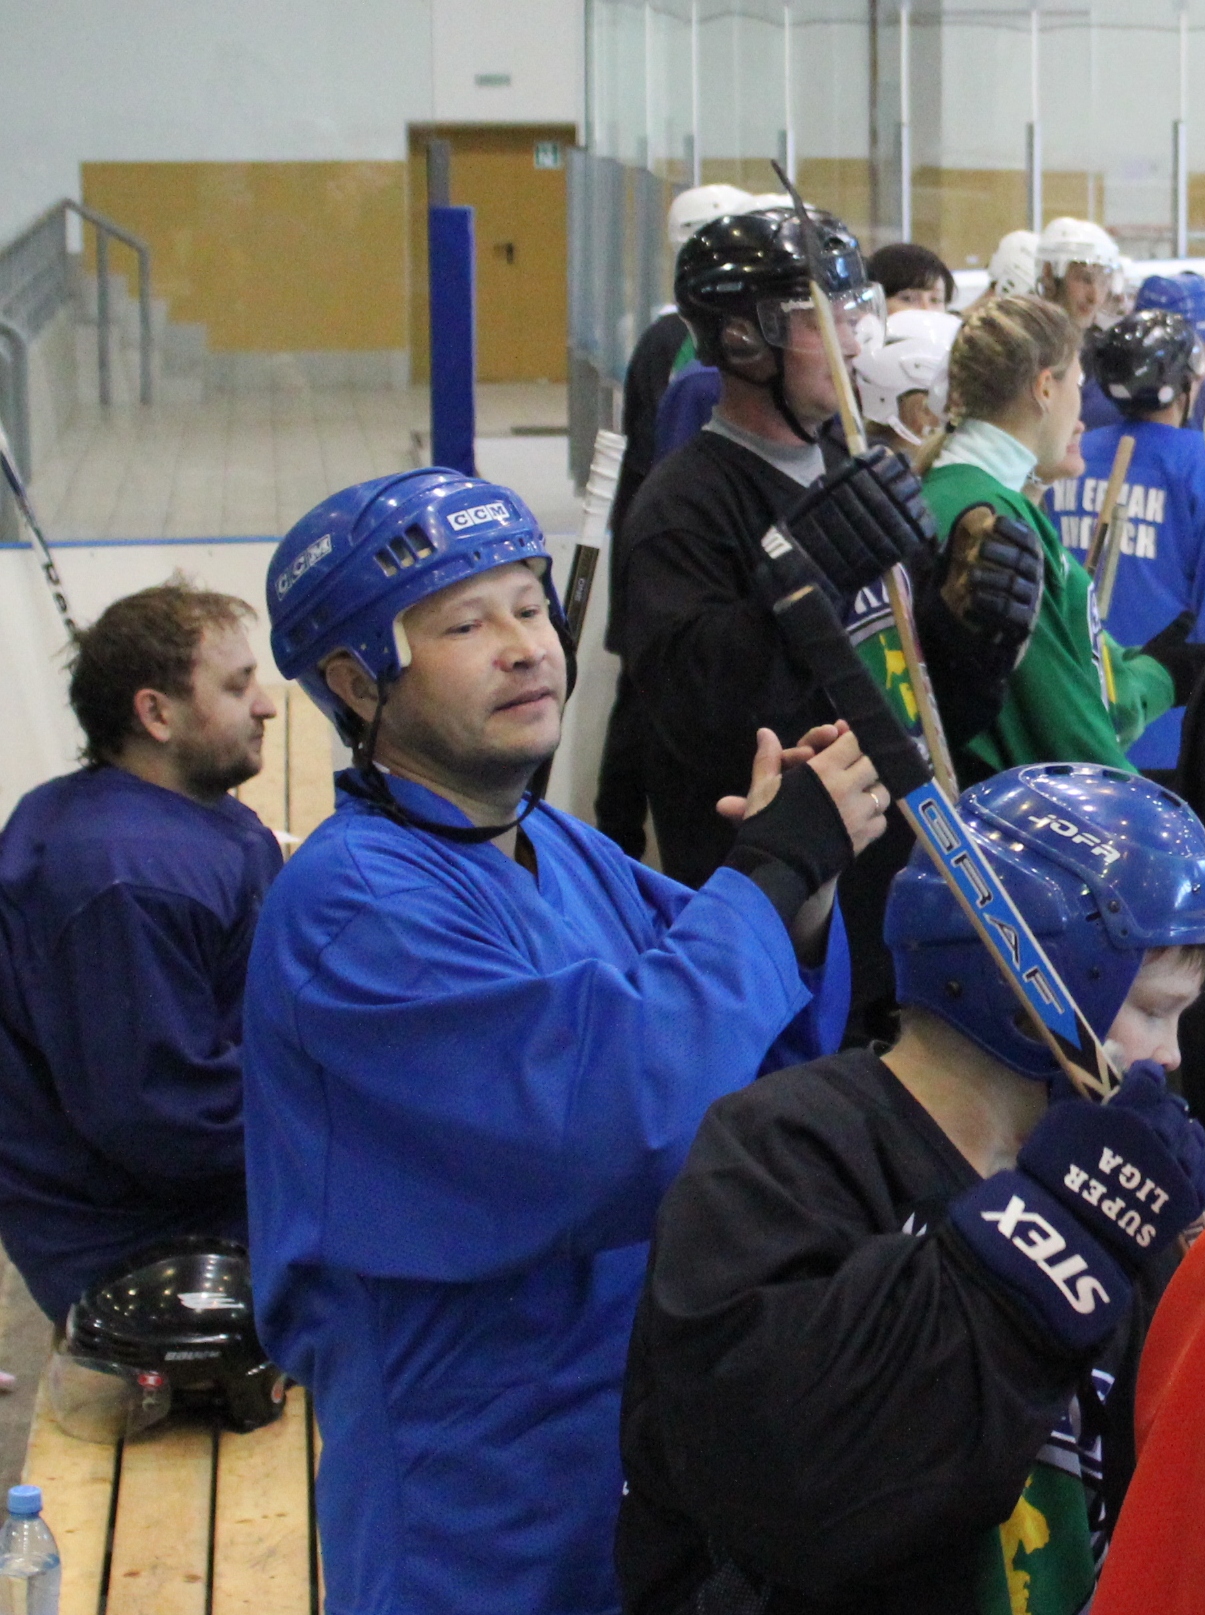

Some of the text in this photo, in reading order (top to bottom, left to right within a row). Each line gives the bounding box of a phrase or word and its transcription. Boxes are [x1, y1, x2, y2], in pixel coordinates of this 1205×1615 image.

[451, 504, 508, 528] CCM
[277, 535, 331, 597] CCM
[1027, 814, 1121, 864] JOFA
[917, 798, 1066, 1015] GRAF
[1063, 1163, 1157, 1248] SUPER
[1098, 1146, 1170, 1215] LIGA
[979, 1193, 1111, 1316] STEX
